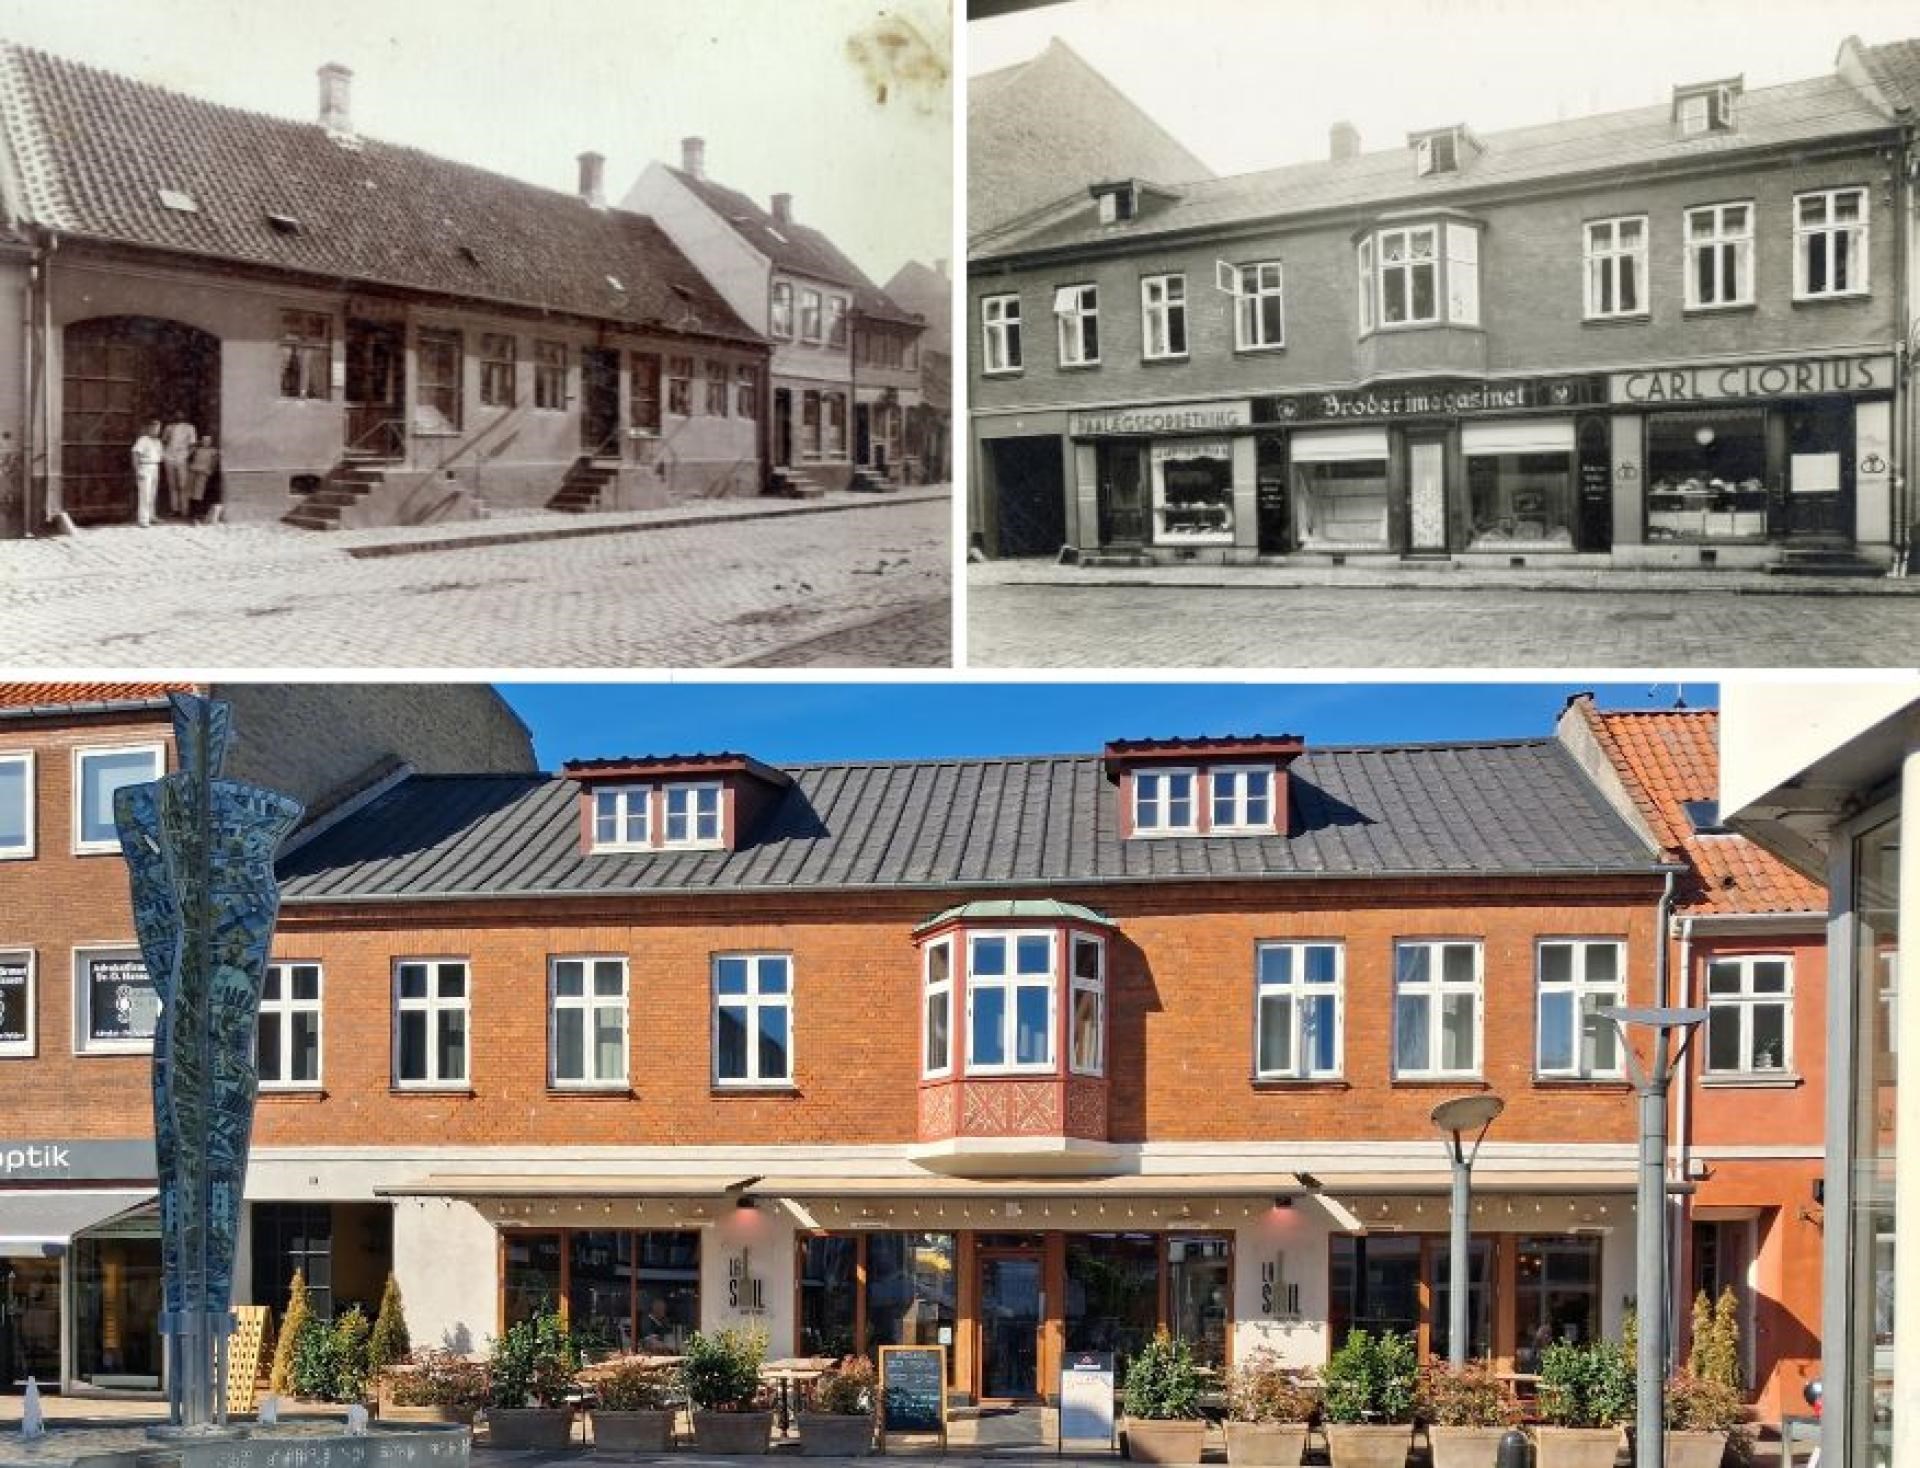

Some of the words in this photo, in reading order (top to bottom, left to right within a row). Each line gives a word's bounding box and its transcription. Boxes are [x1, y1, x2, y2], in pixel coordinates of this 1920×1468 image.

[1626, 371, 1704, 402] CARL
[1718, 358, 1873, 399] CLORIUS
[0, 1145, 71, 1173] ptik
